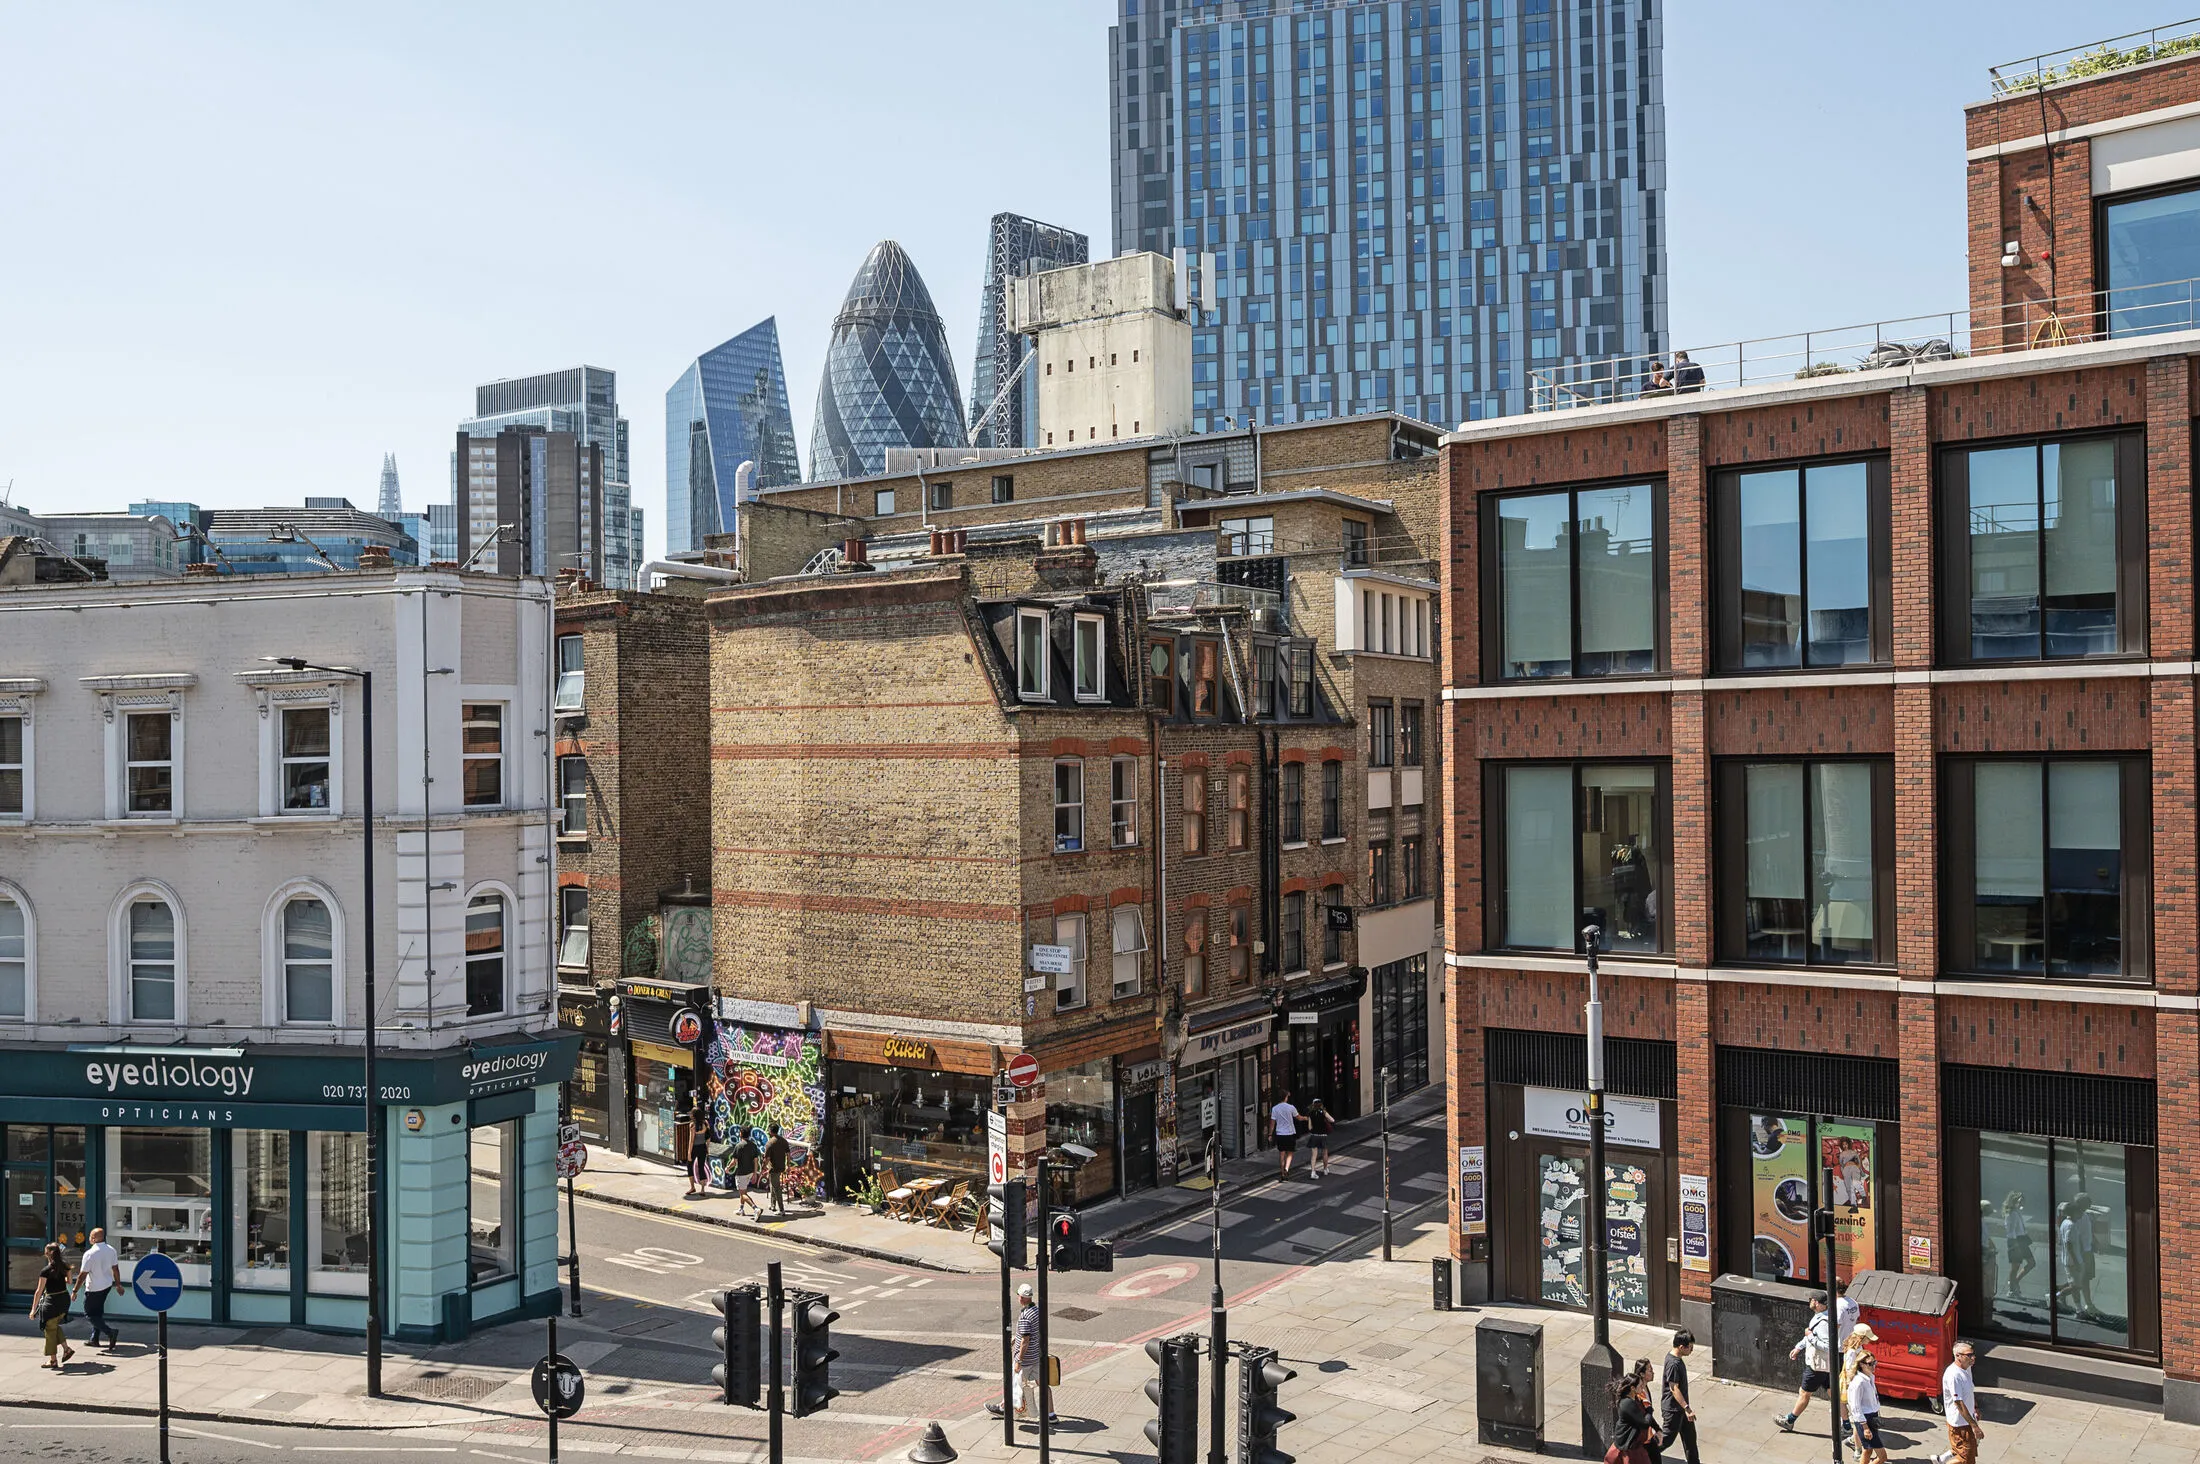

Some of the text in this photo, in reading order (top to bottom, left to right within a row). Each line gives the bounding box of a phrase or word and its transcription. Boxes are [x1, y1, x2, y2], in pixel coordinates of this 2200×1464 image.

[883, 1039, 928, 1059] Kikki
[1200, 1034, 1219, 1052] Dry
[462, 1051, 548, 1080] eyediology
[86, 1057, 254, 1096] eyediology
[323, 1085, 411, 1099] 020 737 2020
[470, 1076, 536, 1095] OPTICIANS
[102, 1108, 232, 1121] OPTICIANS
[1682, 1189, 1705, 1197] OMG
[62, 1201, 80, 1209] EYE
[1684, 1205, 1704, 1213] GOOD
[60, 1213, 84, 1222] TEST
[1610, 1228, 1636, 1240] Ofsted
[1686, 1238, 1704, 1246] Ofsted
[604, 1247, 704, 1274] NO
